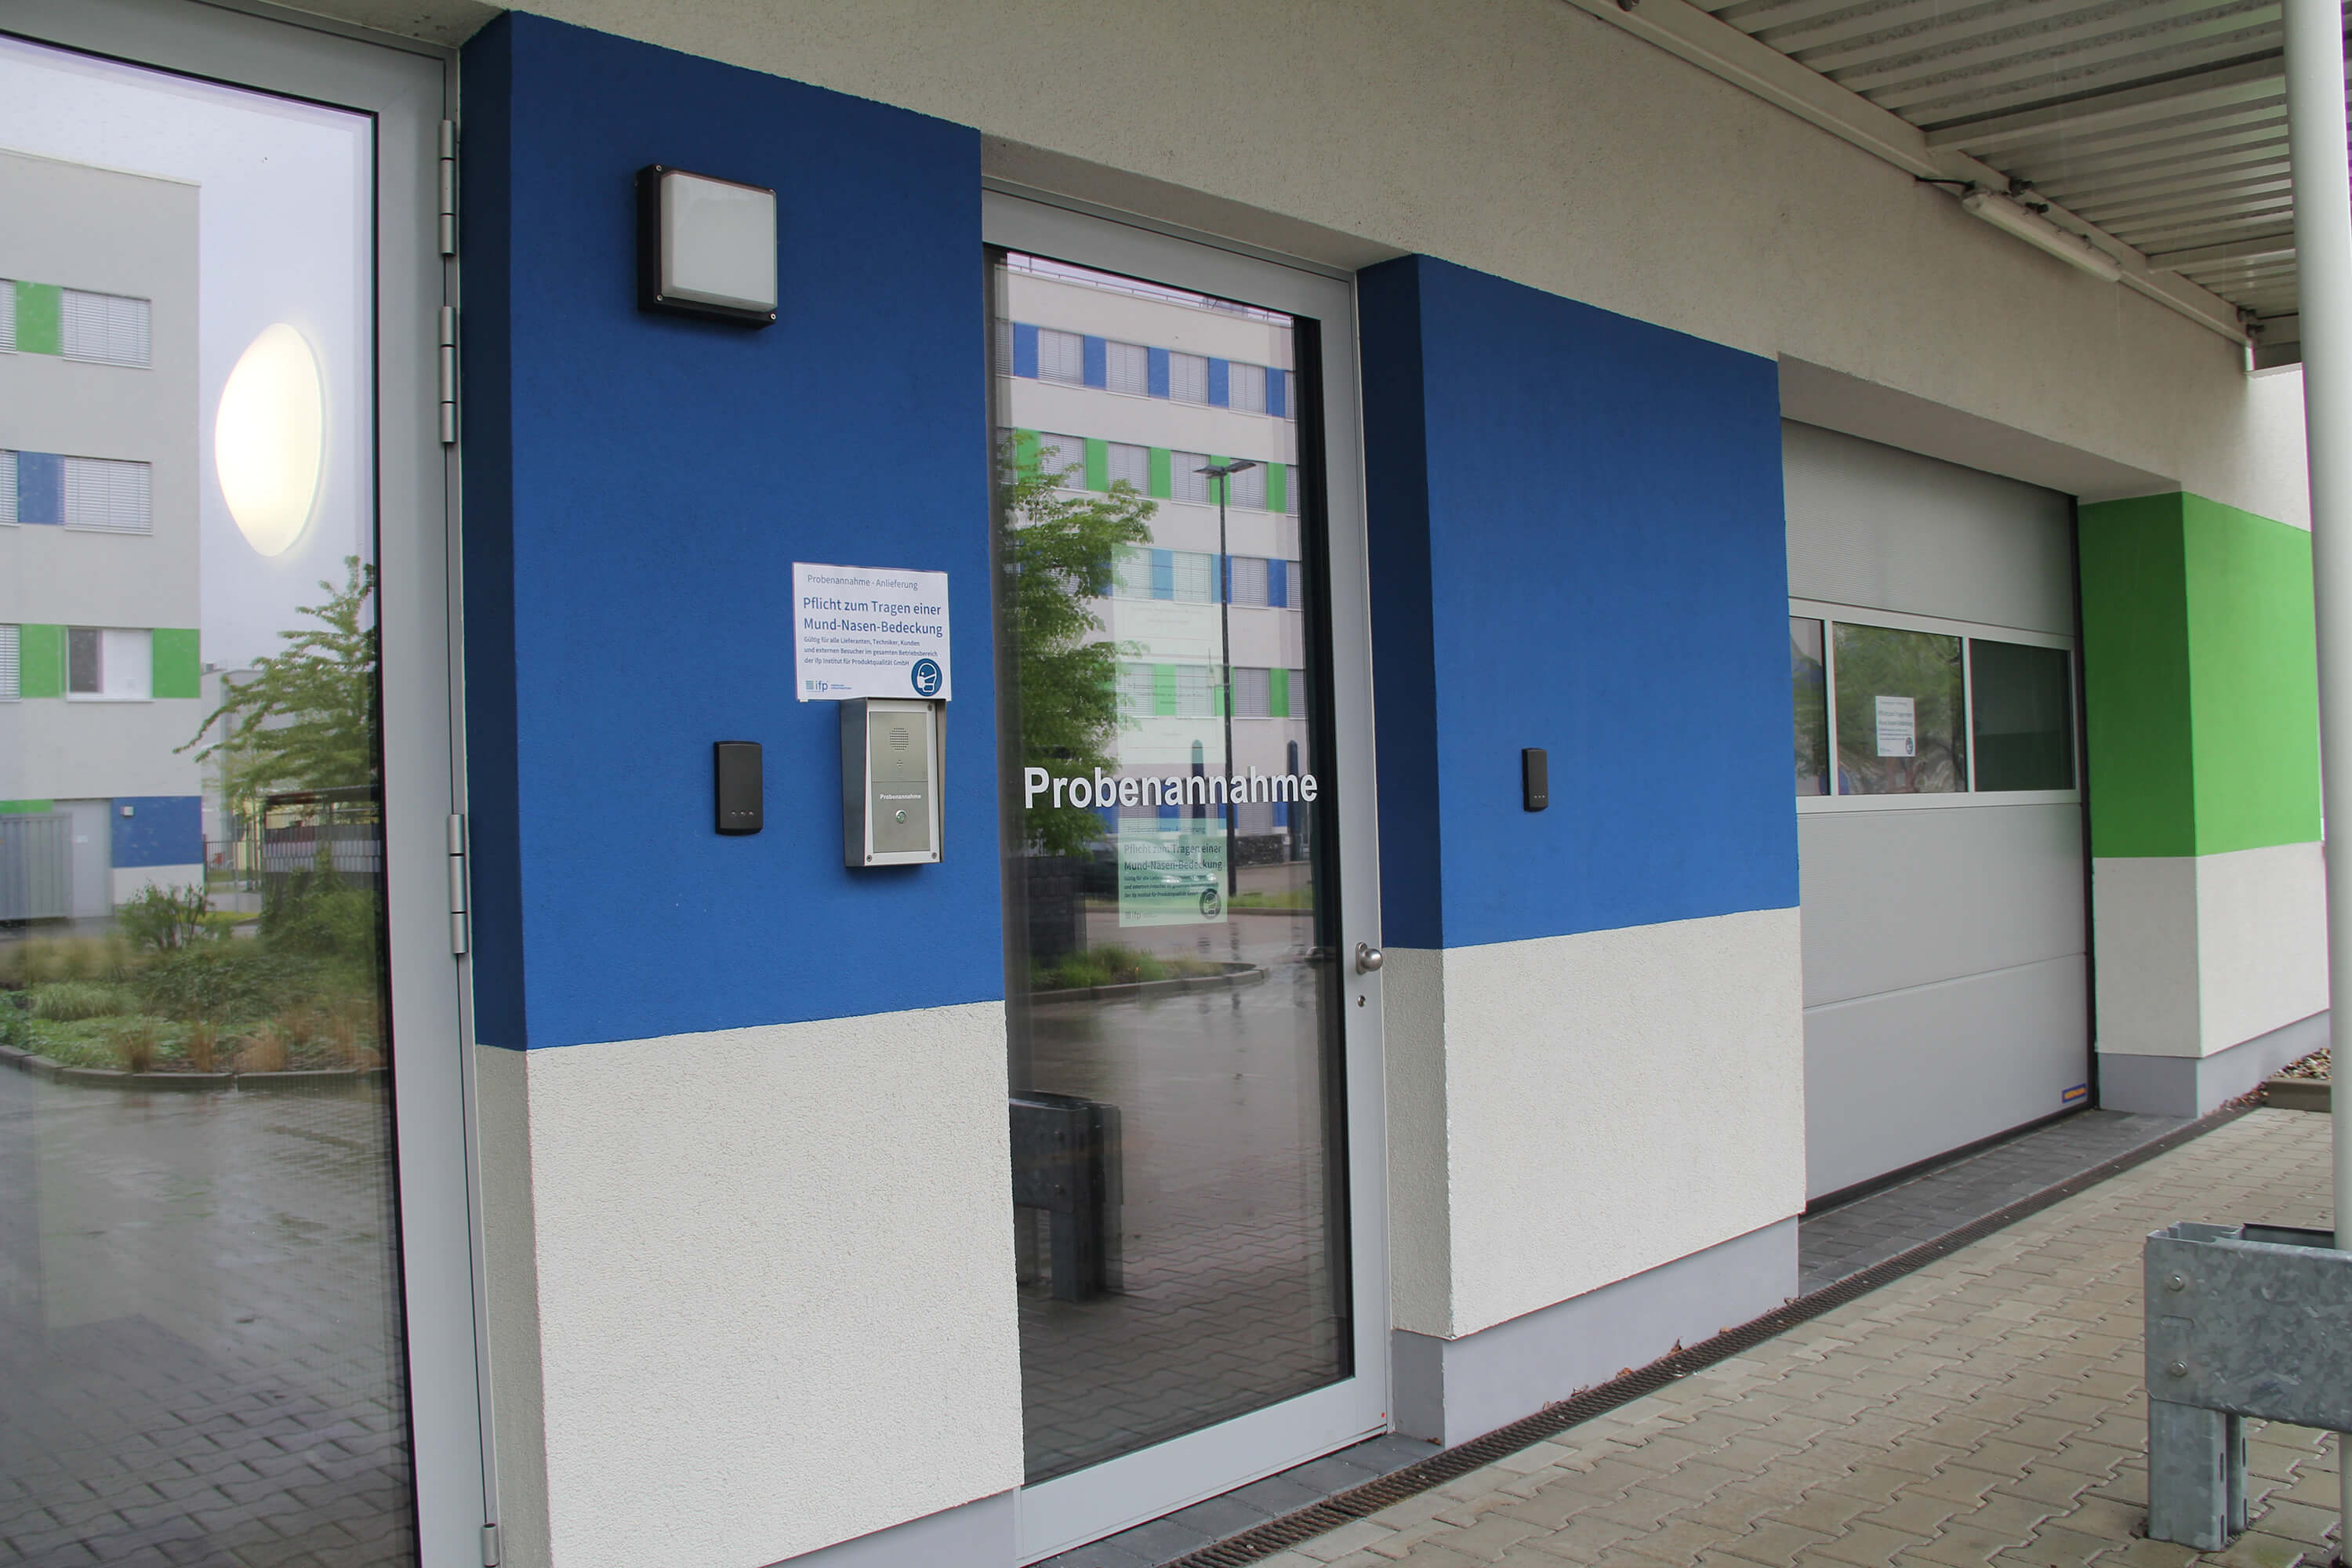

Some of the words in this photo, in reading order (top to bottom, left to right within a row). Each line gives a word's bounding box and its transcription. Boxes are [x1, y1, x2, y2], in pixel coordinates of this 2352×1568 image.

[808, 574, 870, 586] Probenannahme
[876, 579, 918, 591] Anlieferung
[804, 597, 841, 610] Pflicht
[844, 601, 868, 612] zum
[871, 601, 911, 616] Tragen
[913, 602, 942, 615] einer
[804, 618, 942, 638] Mund-Nasen-Bedeckung
[1024, 765, 1319, 809] Probenannahme
[1201, 843, 1221, 854] einer
